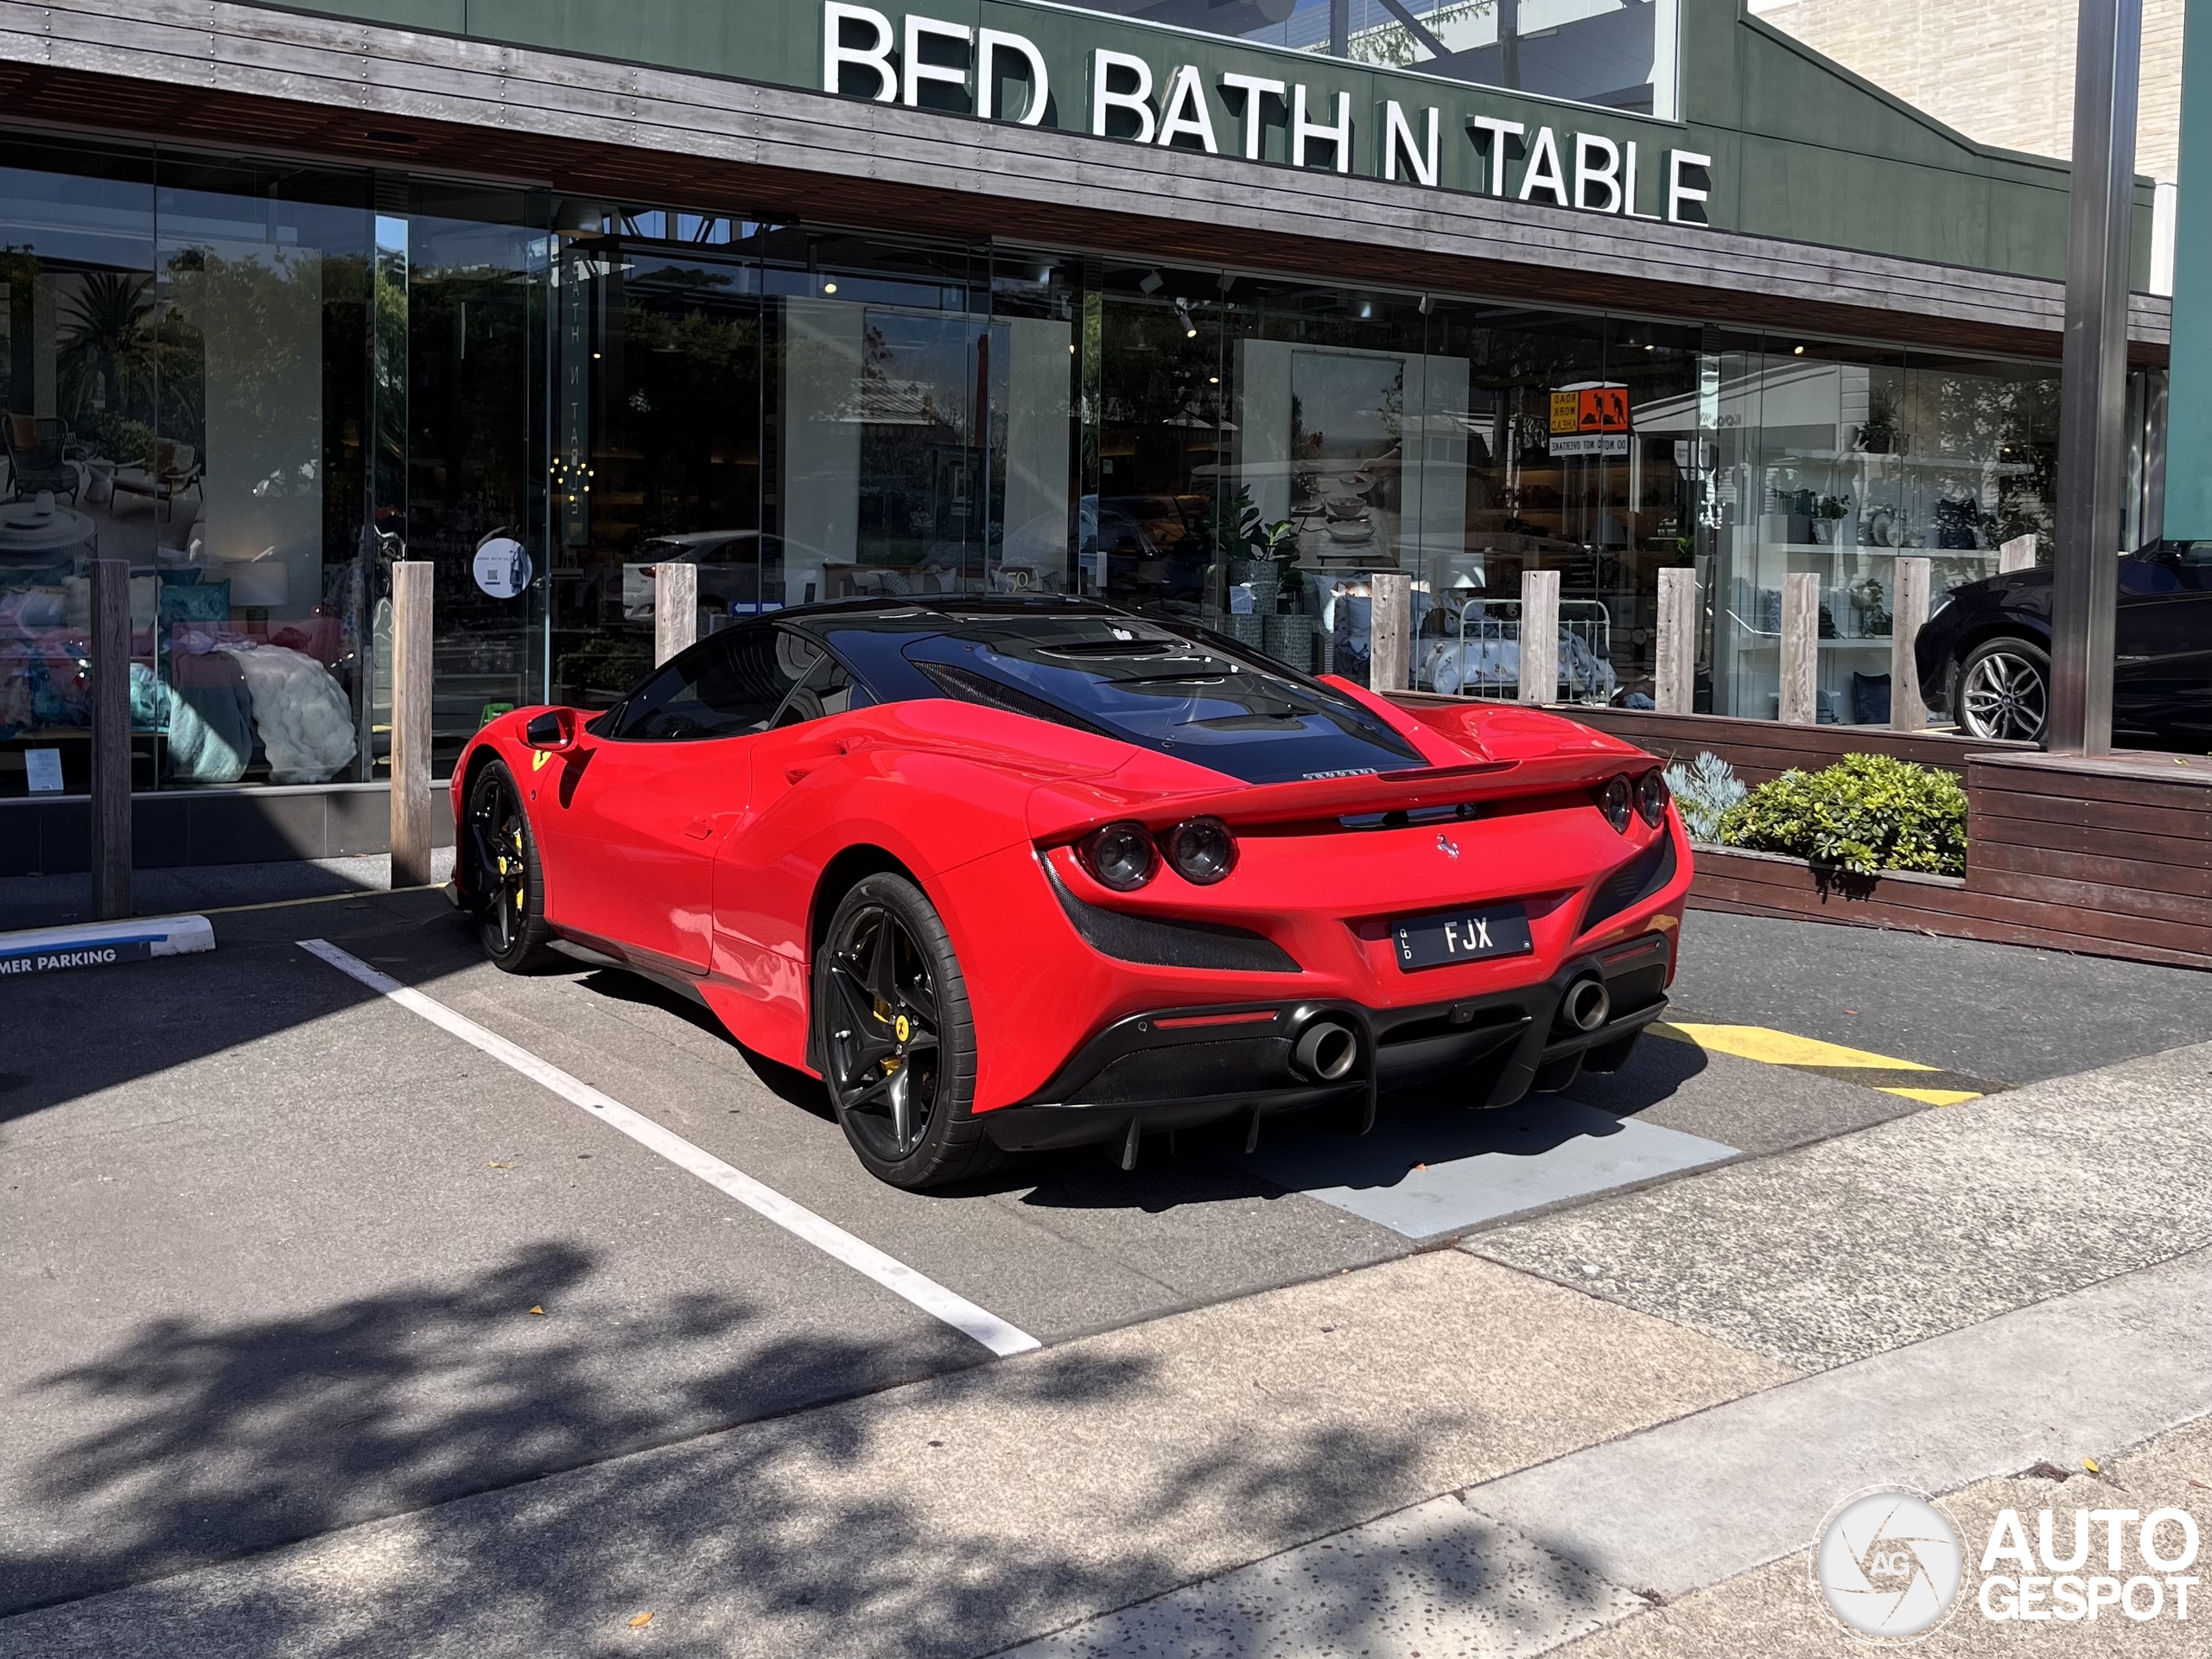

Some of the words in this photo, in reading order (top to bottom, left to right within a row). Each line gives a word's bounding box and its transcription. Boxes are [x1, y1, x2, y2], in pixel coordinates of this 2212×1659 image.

[824, 0, 1049, 126] BED
[1092, 48, 1351, 174] BATH
[1385, 99, 1440, 187] N
[1474, 115, 1712, 227] TABLE
[1399, 928, 1413, 960] QLD
[1444, 916, 1494, 953] FJX
[37, 949, 117, 969] PARKING
